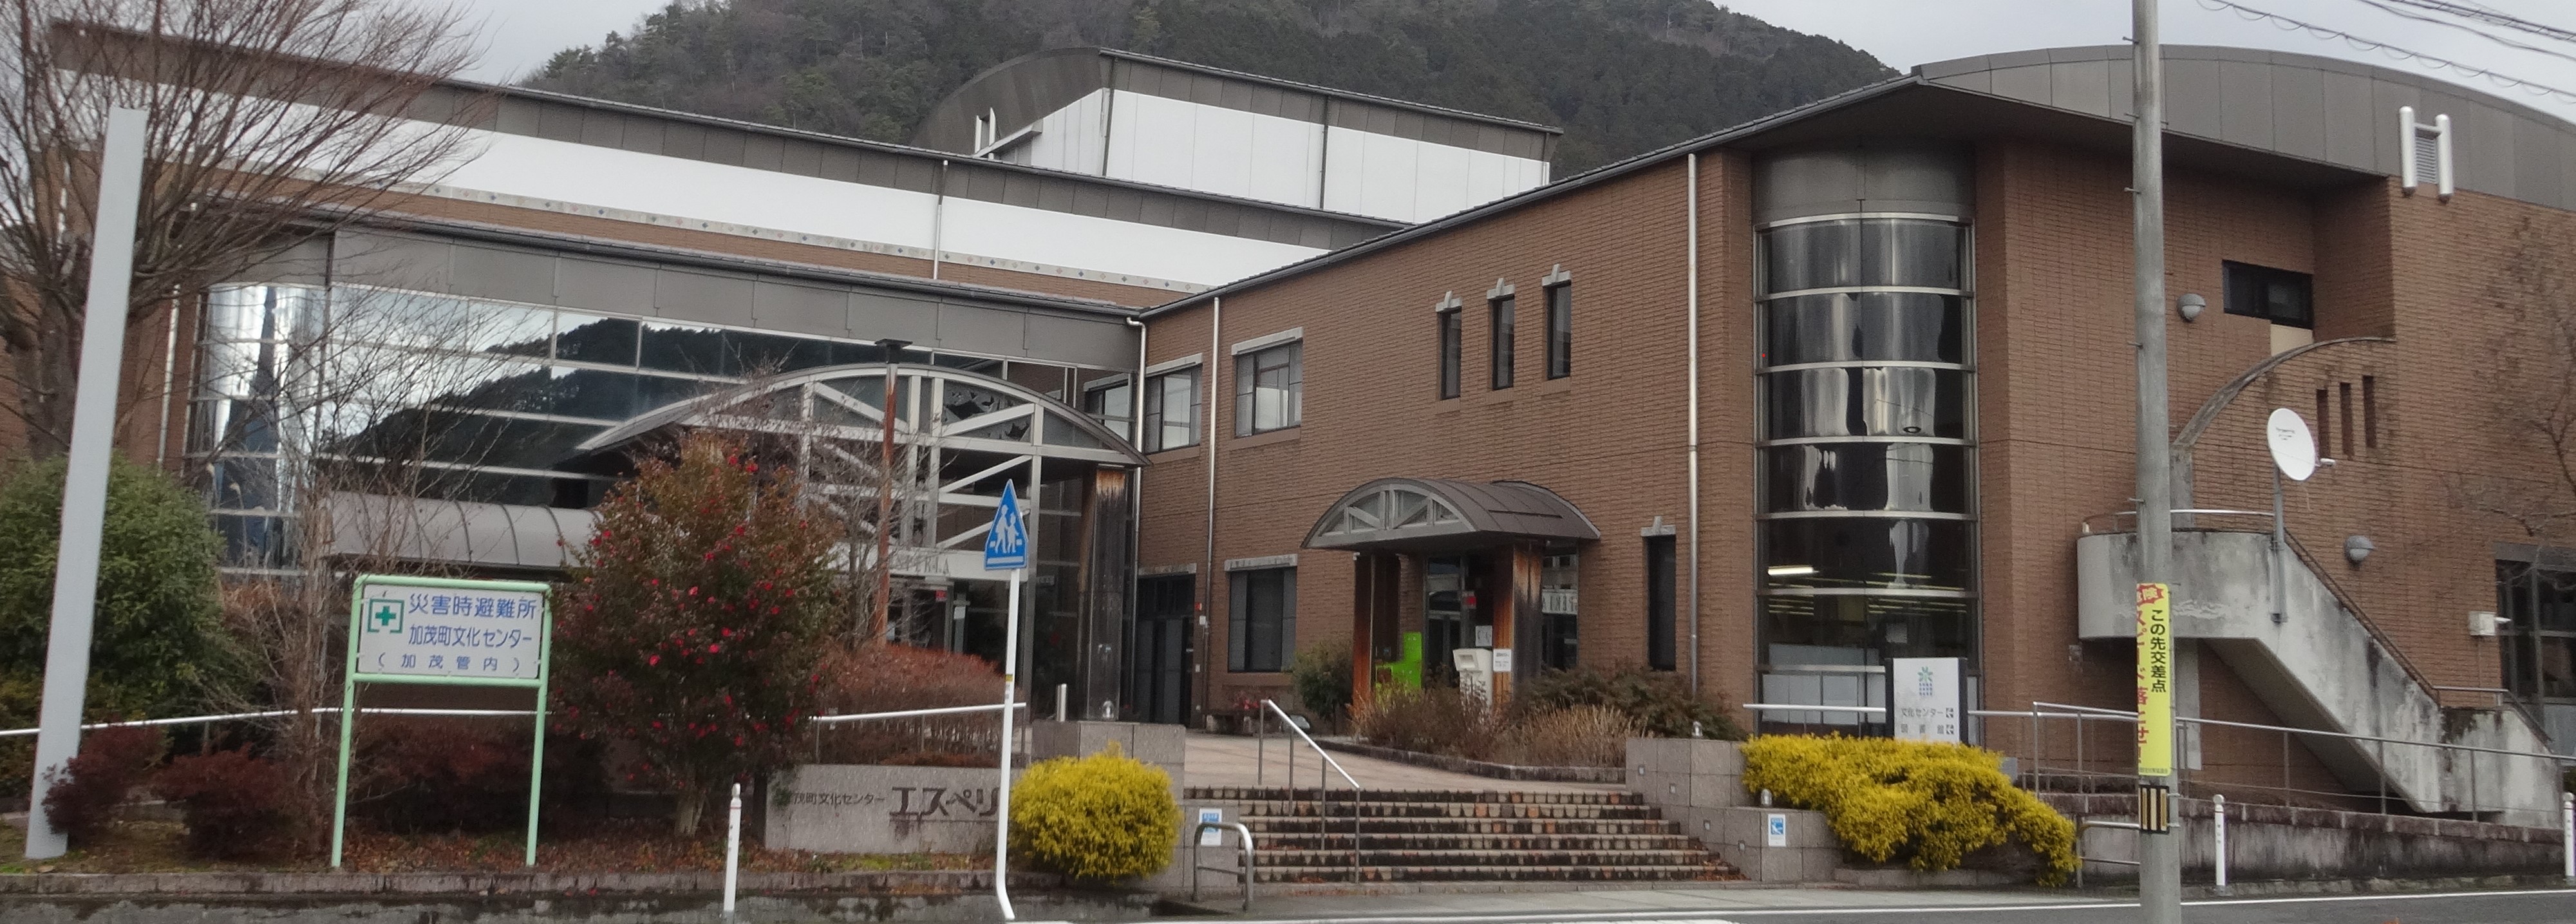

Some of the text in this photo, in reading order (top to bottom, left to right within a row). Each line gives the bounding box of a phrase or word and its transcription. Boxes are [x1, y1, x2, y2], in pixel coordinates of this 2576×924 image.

[408, 592, 538, 620] 災害時避難所
[408, 624, 532, 648] 加茂町文化センター
[2150, 609, 2166, 693] この先交差点
[1901, 707, 1944, 717] 文化センター
[777, 791, 885, 806] 茂町文化センター
